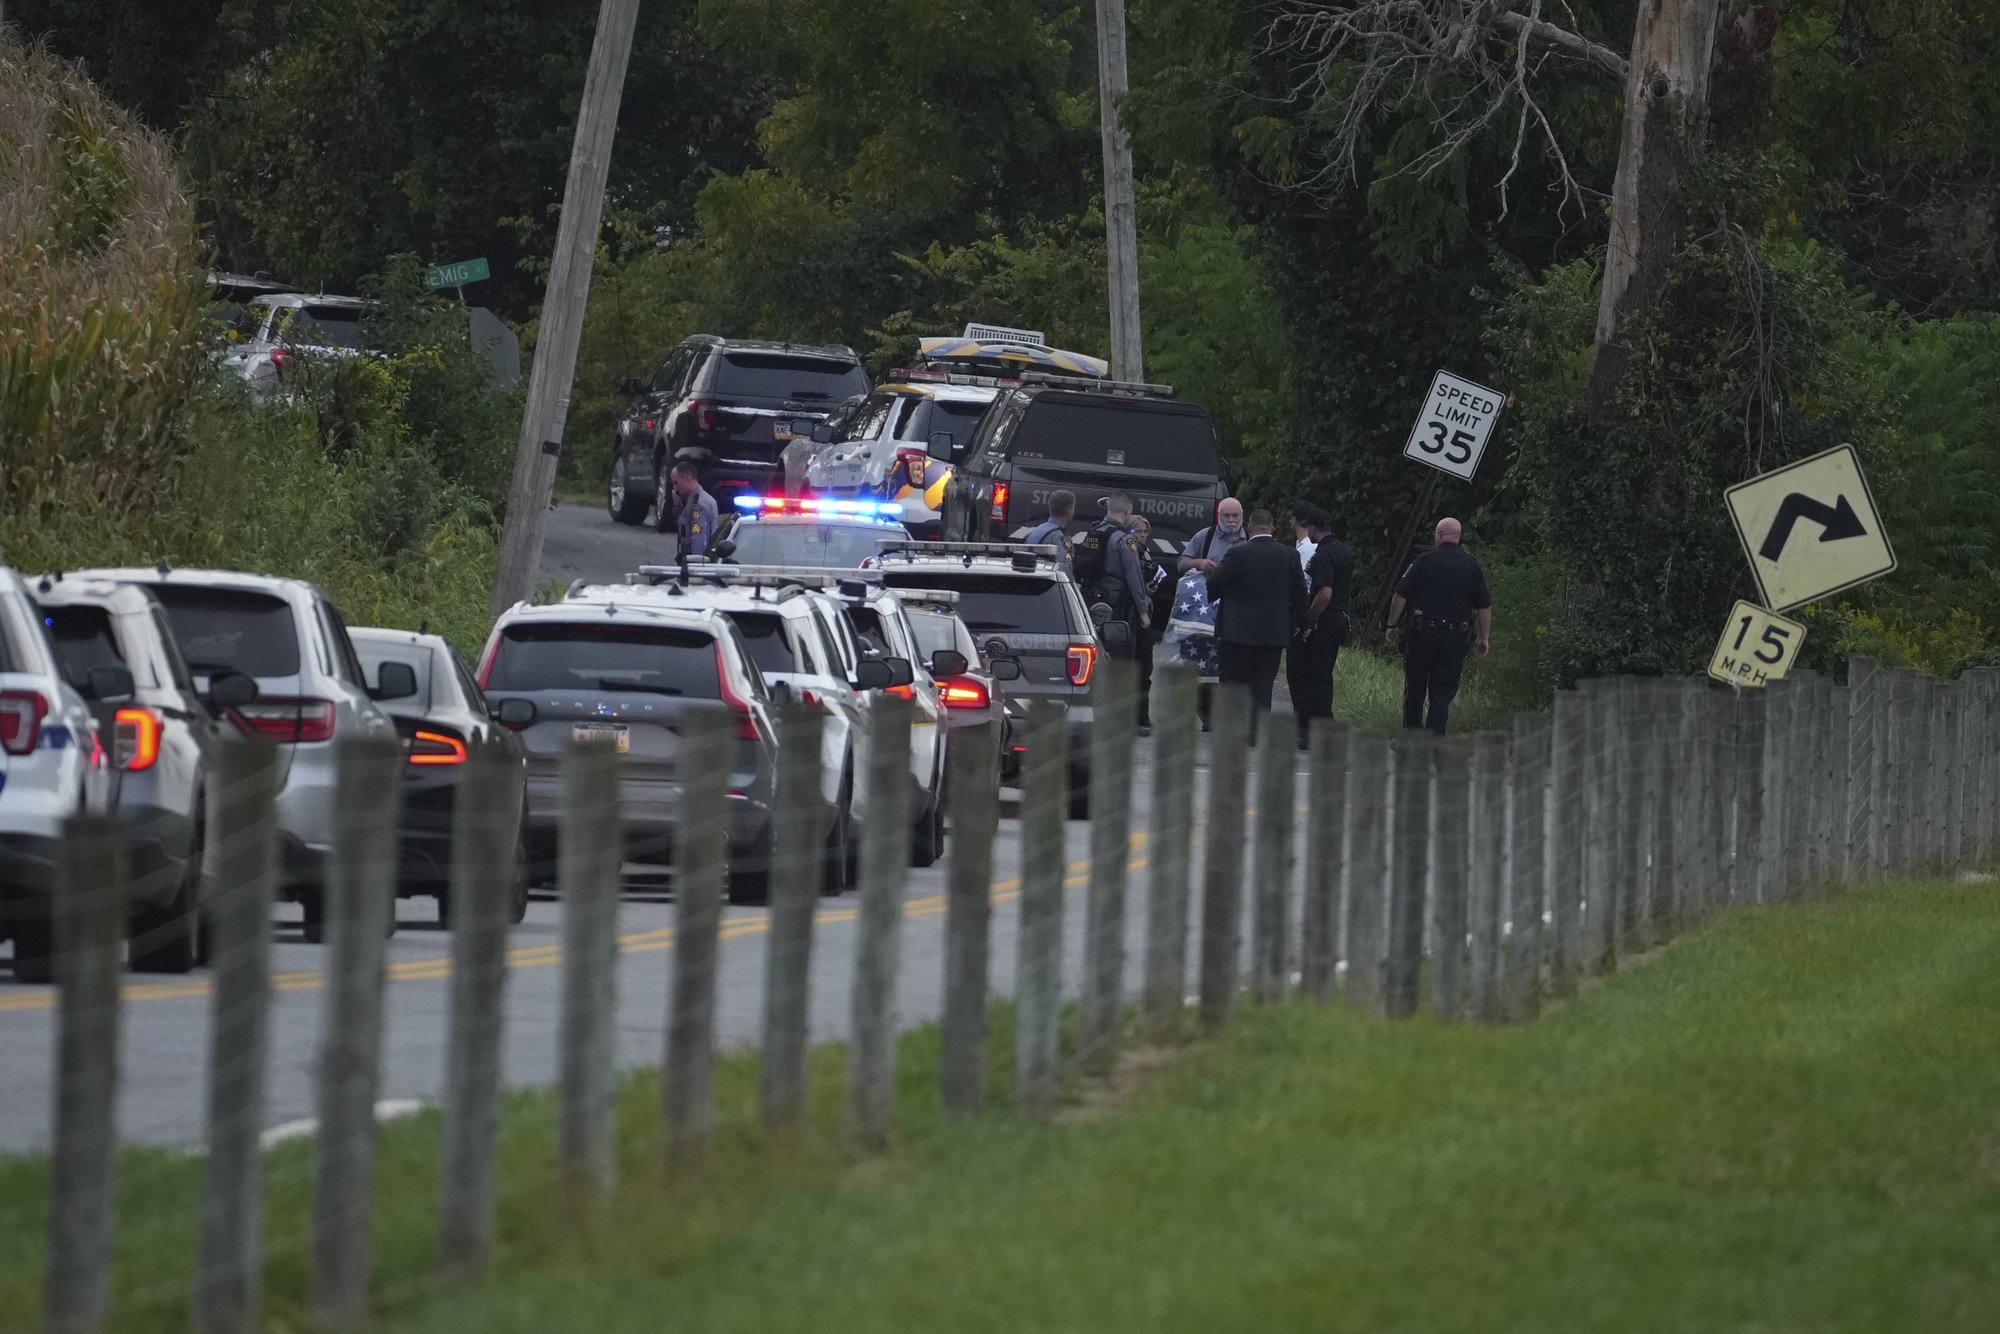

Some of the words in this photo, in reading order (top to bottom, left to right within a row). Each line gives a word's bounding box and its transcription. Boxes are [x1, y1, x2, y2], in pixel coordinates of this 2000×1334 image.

[430, 265, 469, 286] EMIG
[1436, 383, 1494, 415] SPEED
[1434, 402, 1482, 430] LIMIT
[1418, 421, 1477, 464] 35
[1139, 498, 1204, 518] TROOPER
[1733, 615, 1790, 665] 15
